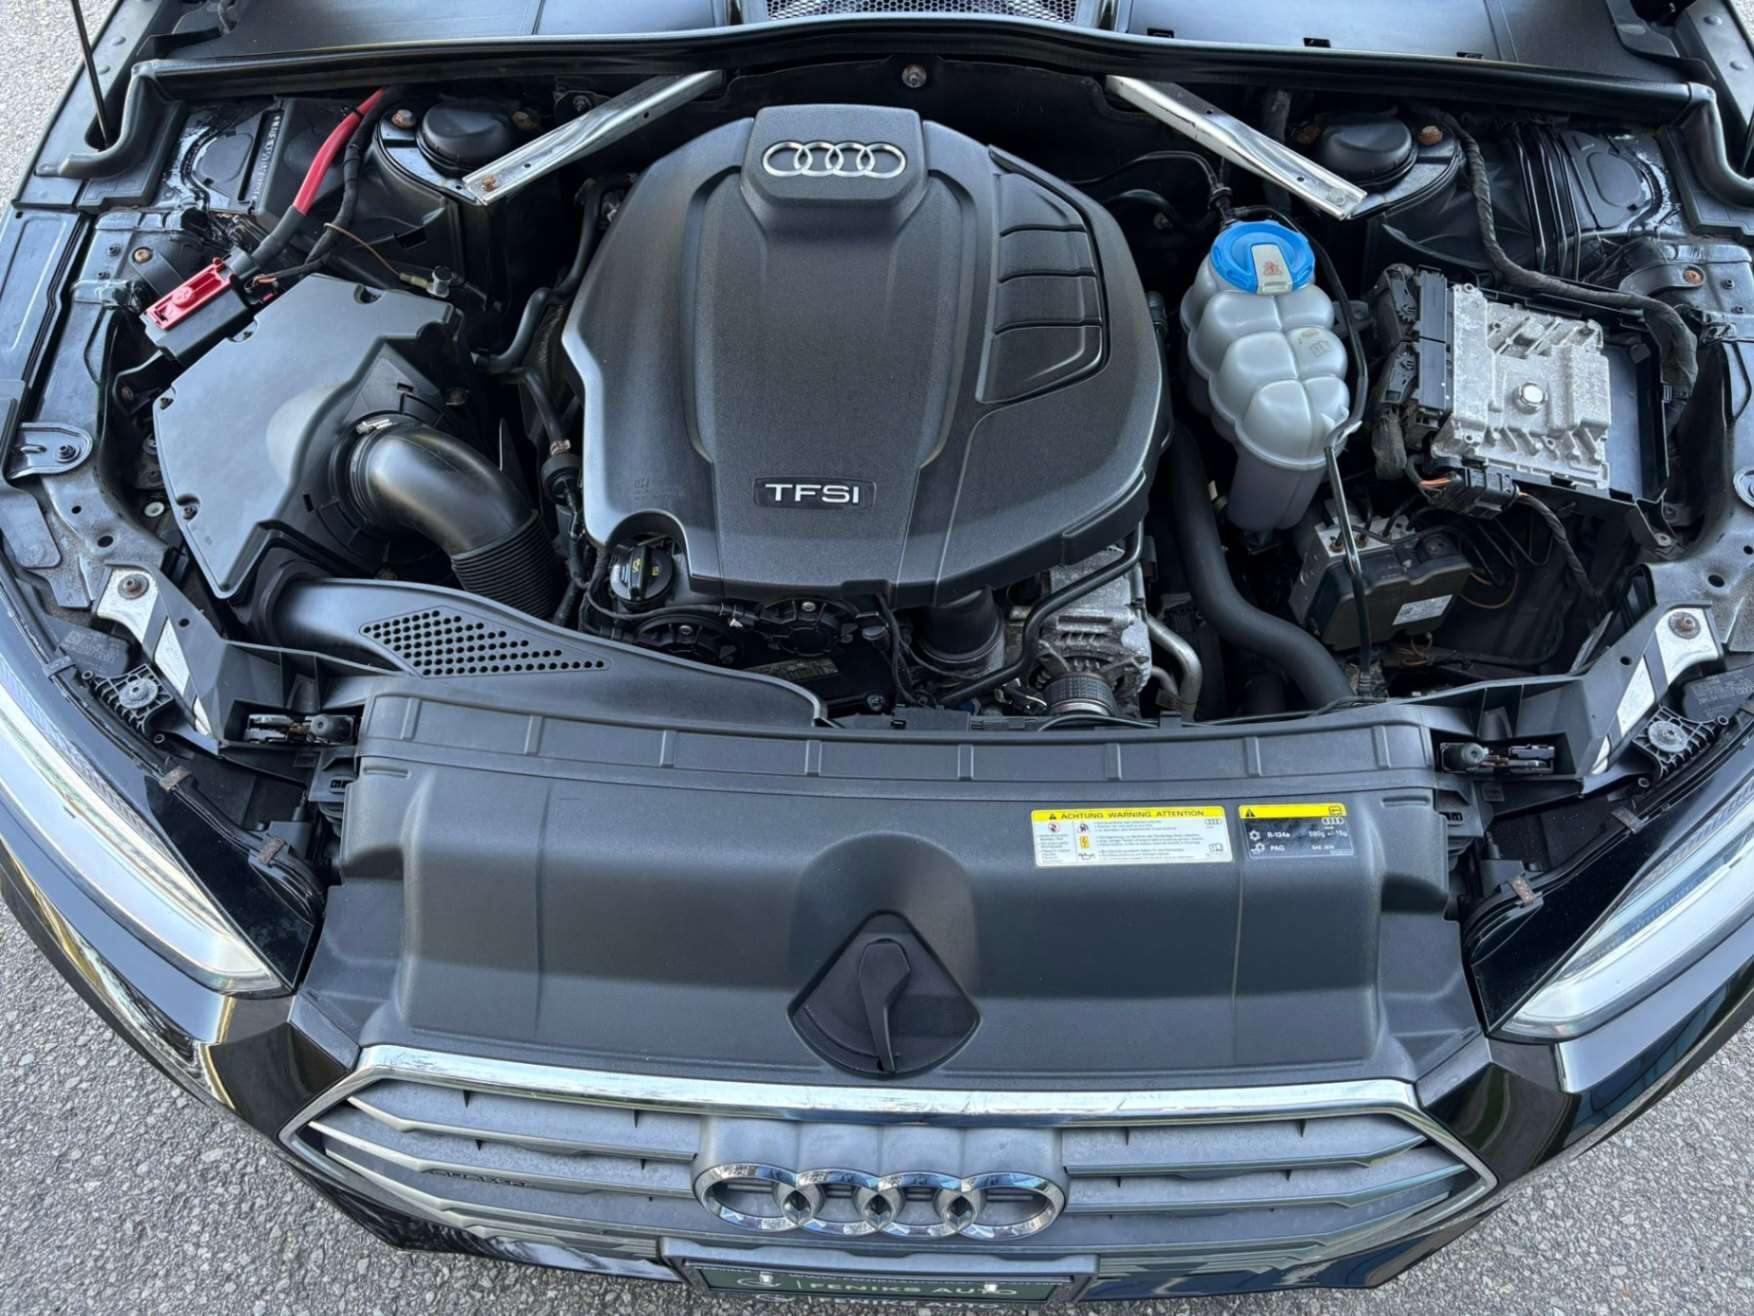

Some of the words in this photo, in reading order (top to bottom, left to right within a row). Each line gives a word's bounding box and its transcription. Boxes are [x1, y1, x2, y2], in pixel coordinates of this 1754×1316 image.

[764, 483, 860, 504] TFSI
[1061, 812, 1104, 820] ACHTUNG
[1108, 811, 1151, 819] WARNING
[1156, 809, 1204, 817] ATTENTION
